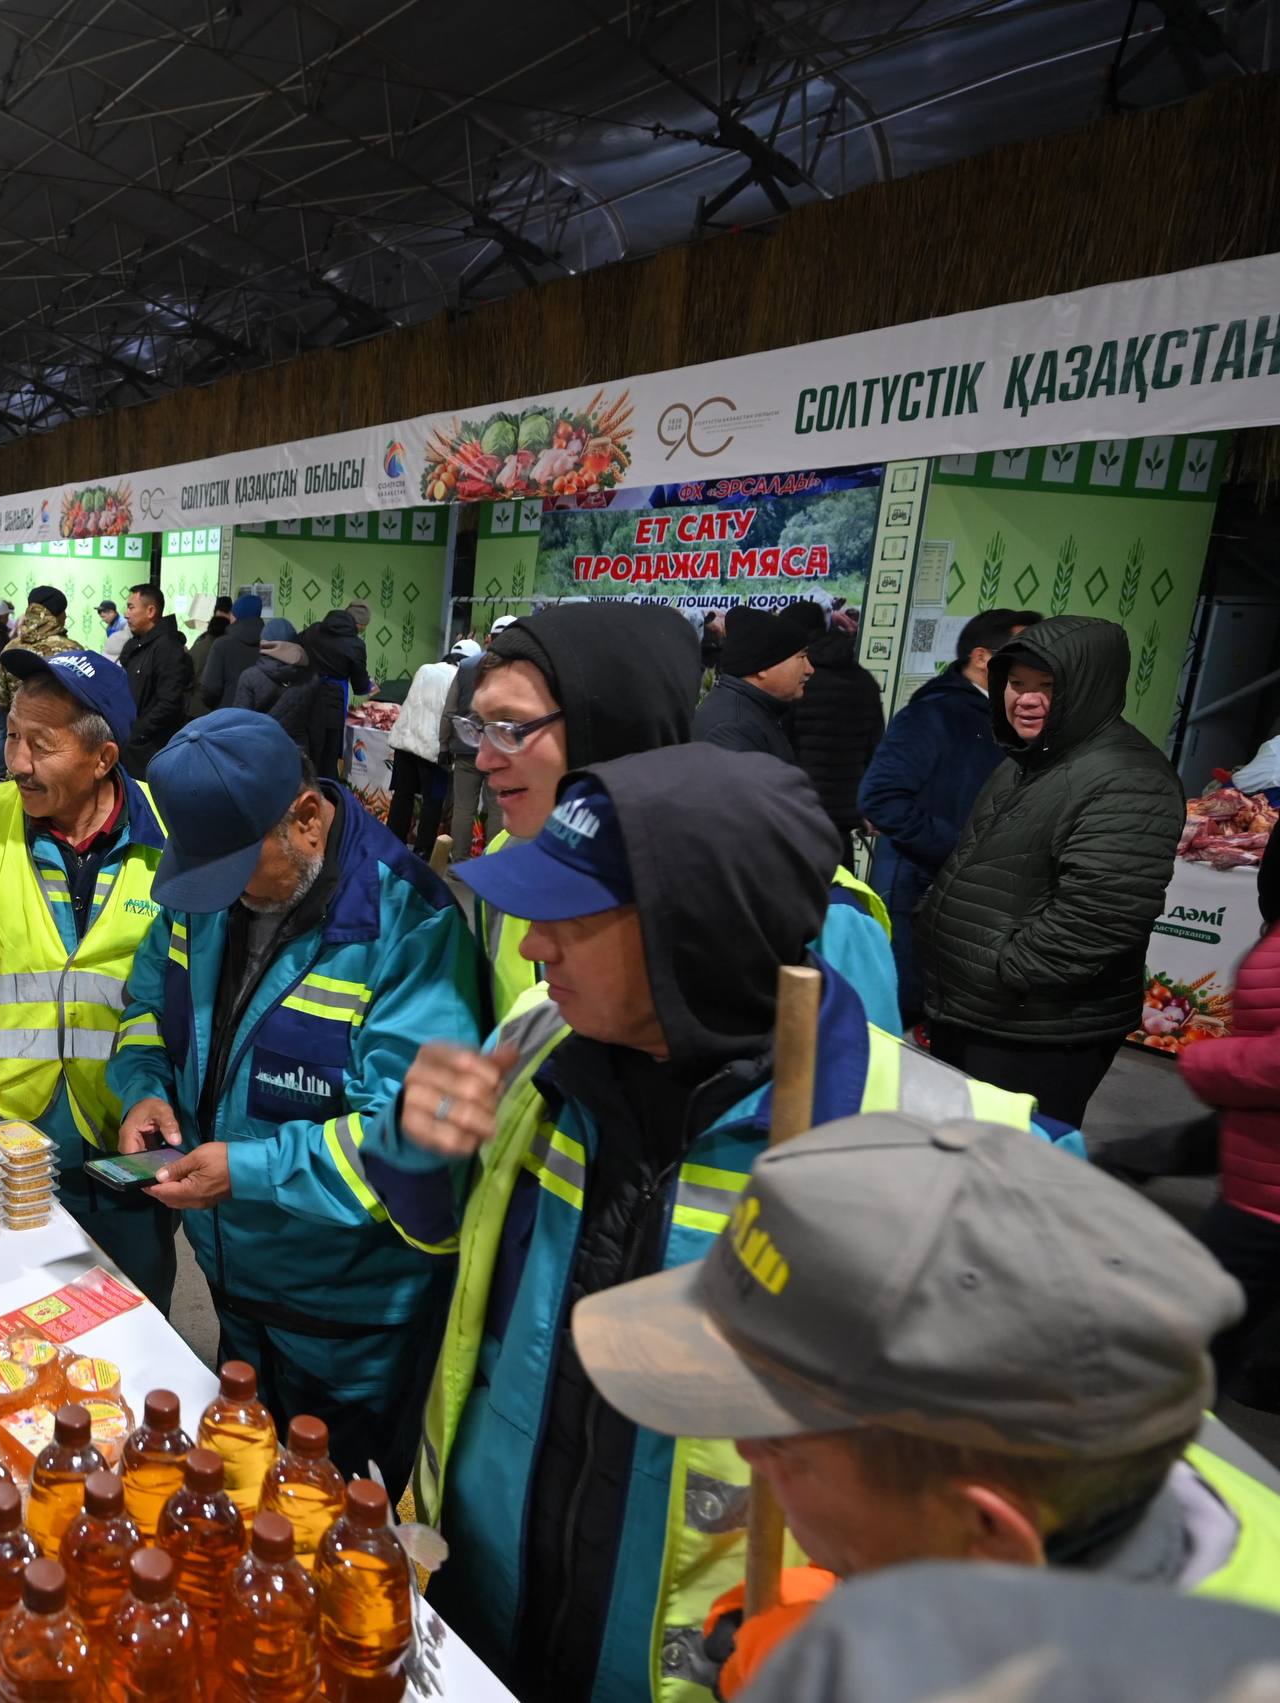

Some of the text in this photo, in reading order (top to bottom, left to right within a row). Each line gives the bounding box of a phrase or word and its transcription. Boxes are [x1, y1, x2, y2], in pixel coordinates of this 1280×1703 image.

[794, 314, 1280, 435] СОЛТҮСТІК ҚАЗАҚСТАН
[181, 458, 365, 511] СОЛТҮСТІК ҚАЗАҚСТАН ОБЛЫСЫ
[678, 482, 705, 500] ФХ
[634, 508, 757, 545] ЕТ САТУ
[573, 545, 830, 585] ПРОДАЖА МЯСА
